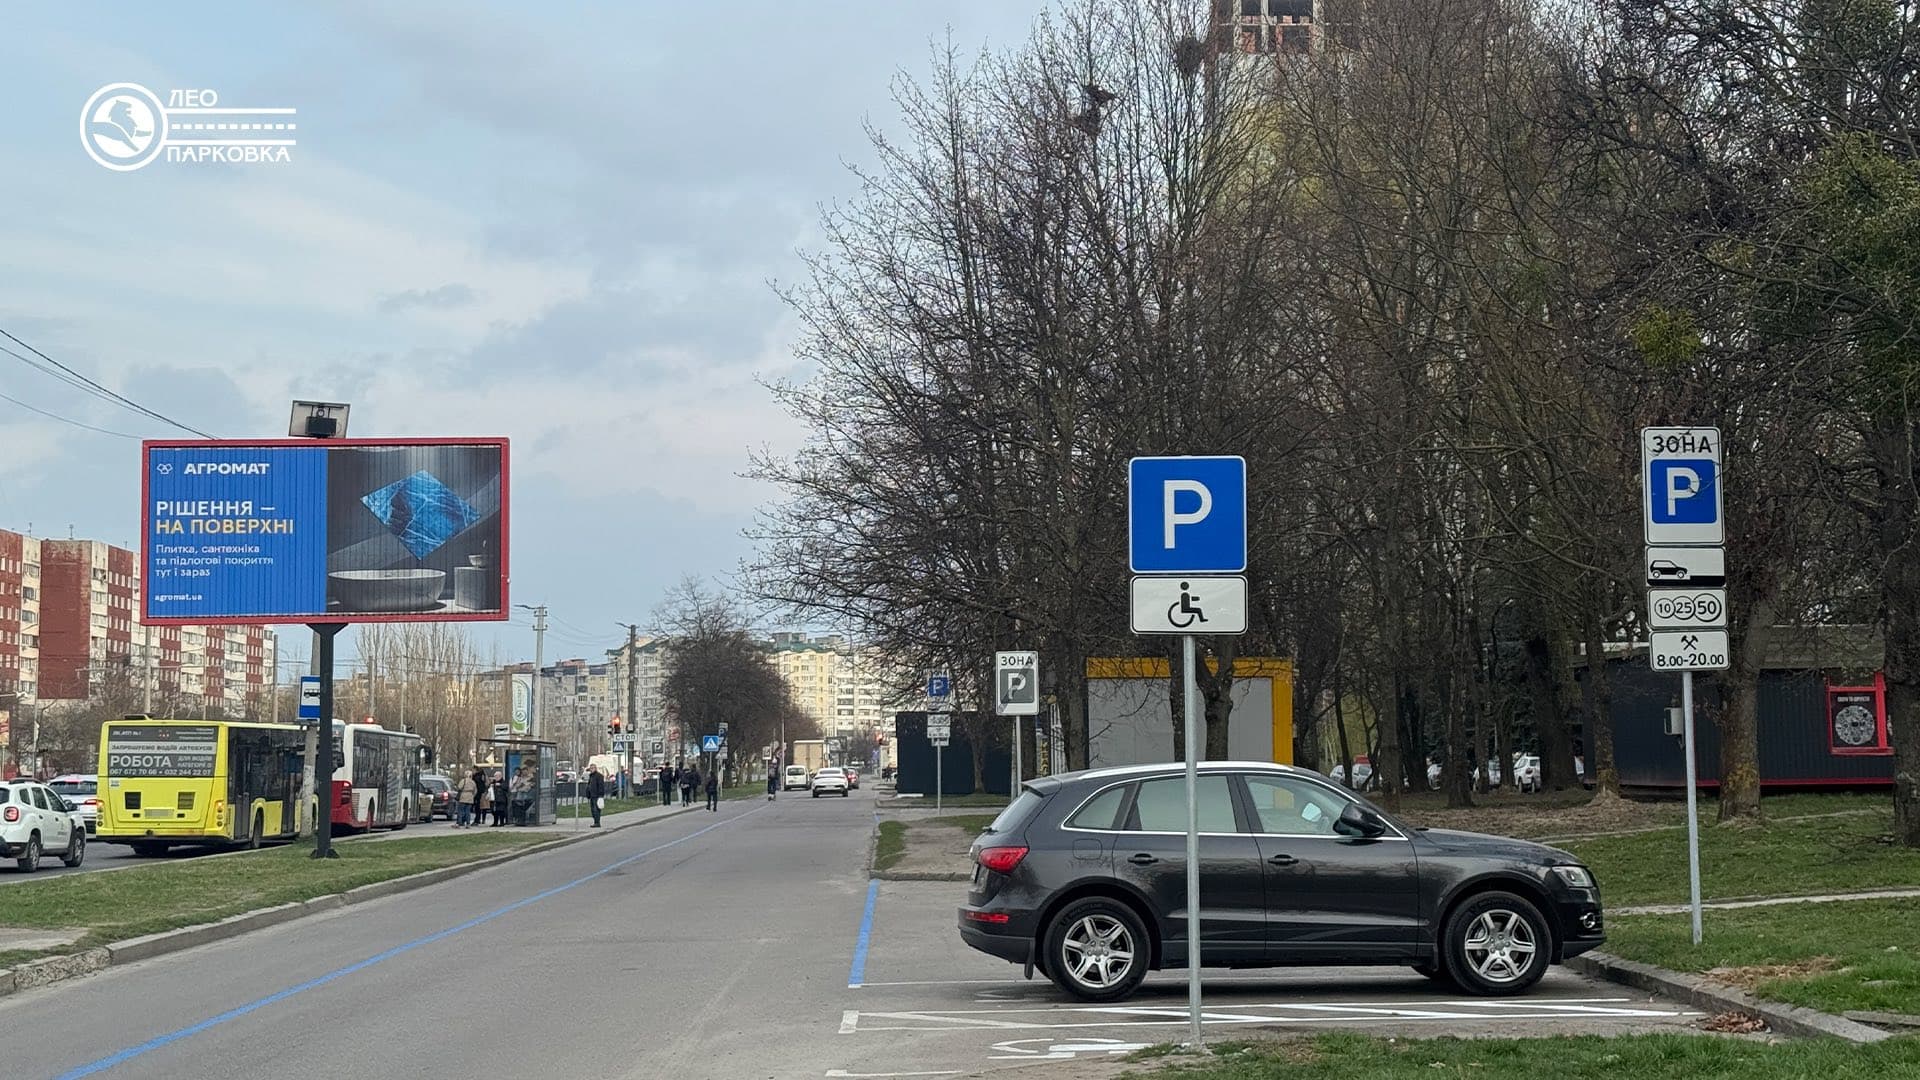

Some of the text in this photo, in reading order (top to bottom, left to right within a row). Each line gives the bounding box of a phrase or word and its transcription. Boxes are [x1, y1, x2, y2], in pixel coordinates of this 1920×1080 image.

[1652, 435, 1712, 453] ЗОНА
[184, 463, 270, 475] АГРОМАТ
[1667, 467, 1700, 516] P
[156, 501, 253, 516] РІШЕННЯ
[1164, 479, 1213, 549] P
[156, 519, 294, 534] НА ПОВЕРХНІ
[156, 544, 260, 555] Плитка, сантехніка
[169, 556, 221, 567] підлогові
[225, 557, 274, 567] покриття
[155, 569, 170, 578] тут
[180, 569, 211, 578] зараз
[154, 594, 202, 602] agromat.ua
[1658, 601, 1717, 614] 10 25 50
[1001, 656, 1033, 666] ЗОНА
[1657, 653, 1725, 667] 8.00-20.00
[1007, 672, 1026, 699] P
[110, 755, 171, 767] РОБОТА
